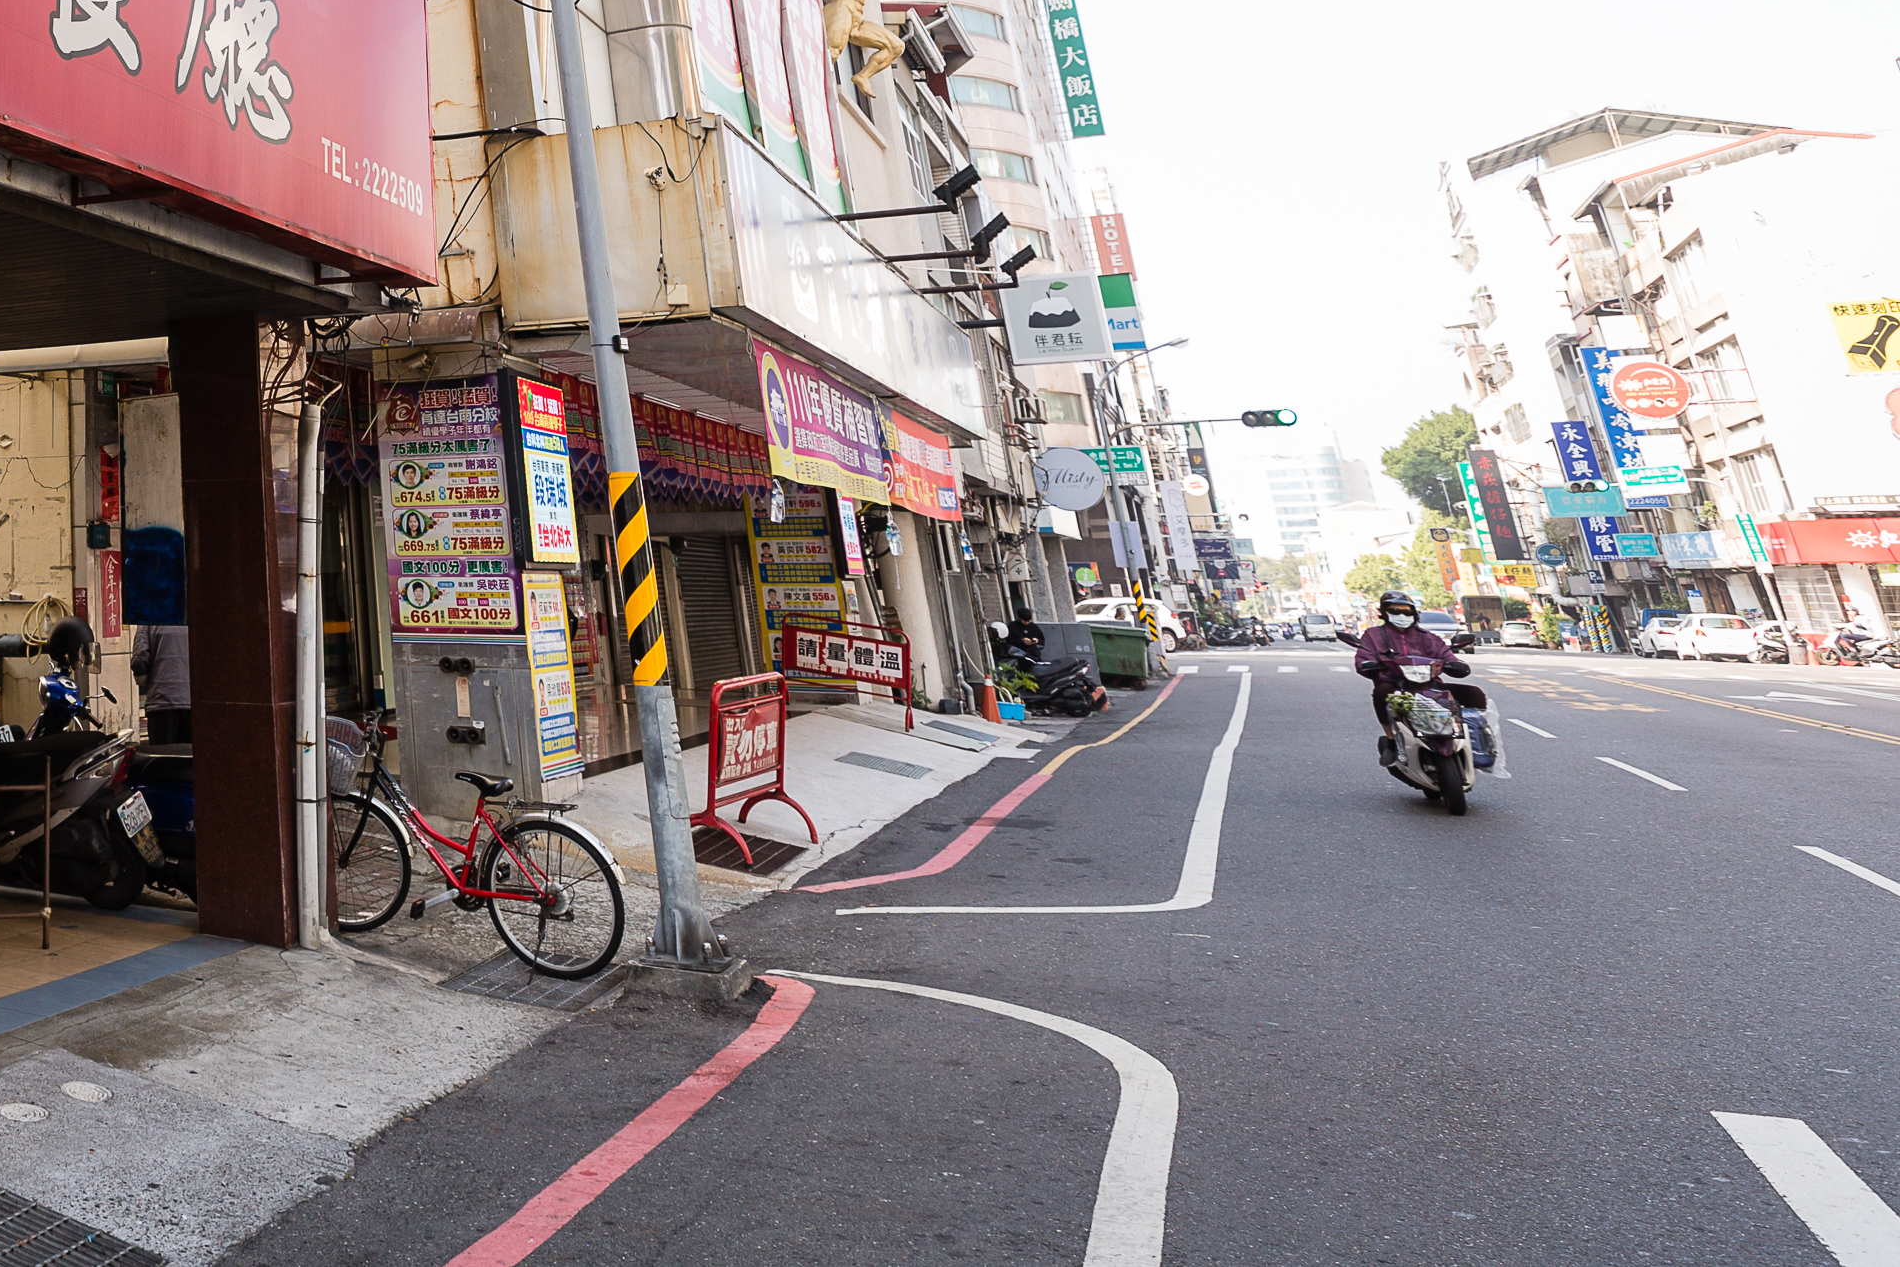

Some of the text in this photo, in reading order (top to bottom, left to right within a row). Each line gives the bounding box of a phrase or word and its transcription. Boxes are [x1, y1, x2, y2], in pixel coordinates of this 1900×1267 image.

[321, 136, 423, 216] TEL:2222509
[1035, 332, 1083, 347] 伴君耘
[786, 367, 879, 451] 110年優質補習班
[1561, 423, 1593, 478] 永全興
[400, 486, 500, 503] 674.5 75滿級分
[1629, 497, 1666, 505] 2224055
[404, 536, 505, 552] 669.75 75滿級分
[402, 560, 460, 574] 國文100分
[410, 607, 511, 623] 661 國文100分
[798, 637, 901, 671] 請量體溫
